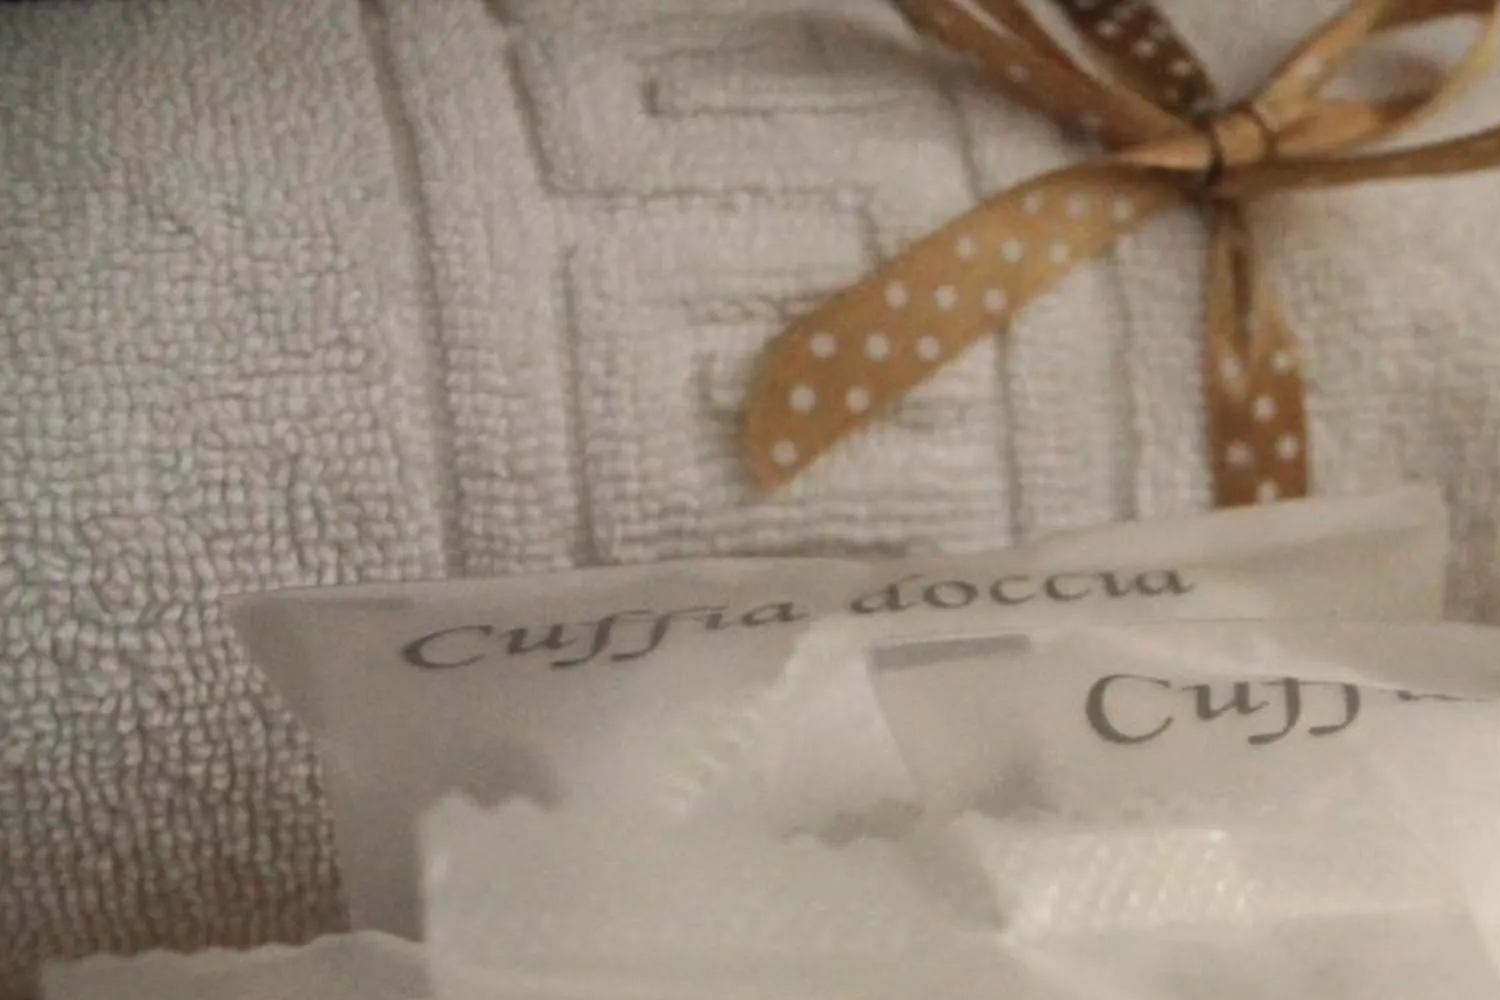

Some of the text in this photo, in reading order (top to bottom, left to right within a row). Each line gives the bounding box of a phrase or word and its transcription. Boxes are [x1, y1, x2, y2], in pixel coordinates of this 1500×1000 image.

[403, 567, 1196, 669] Cuffia doccia
[1085, 673, 1465, 745] Cuff
